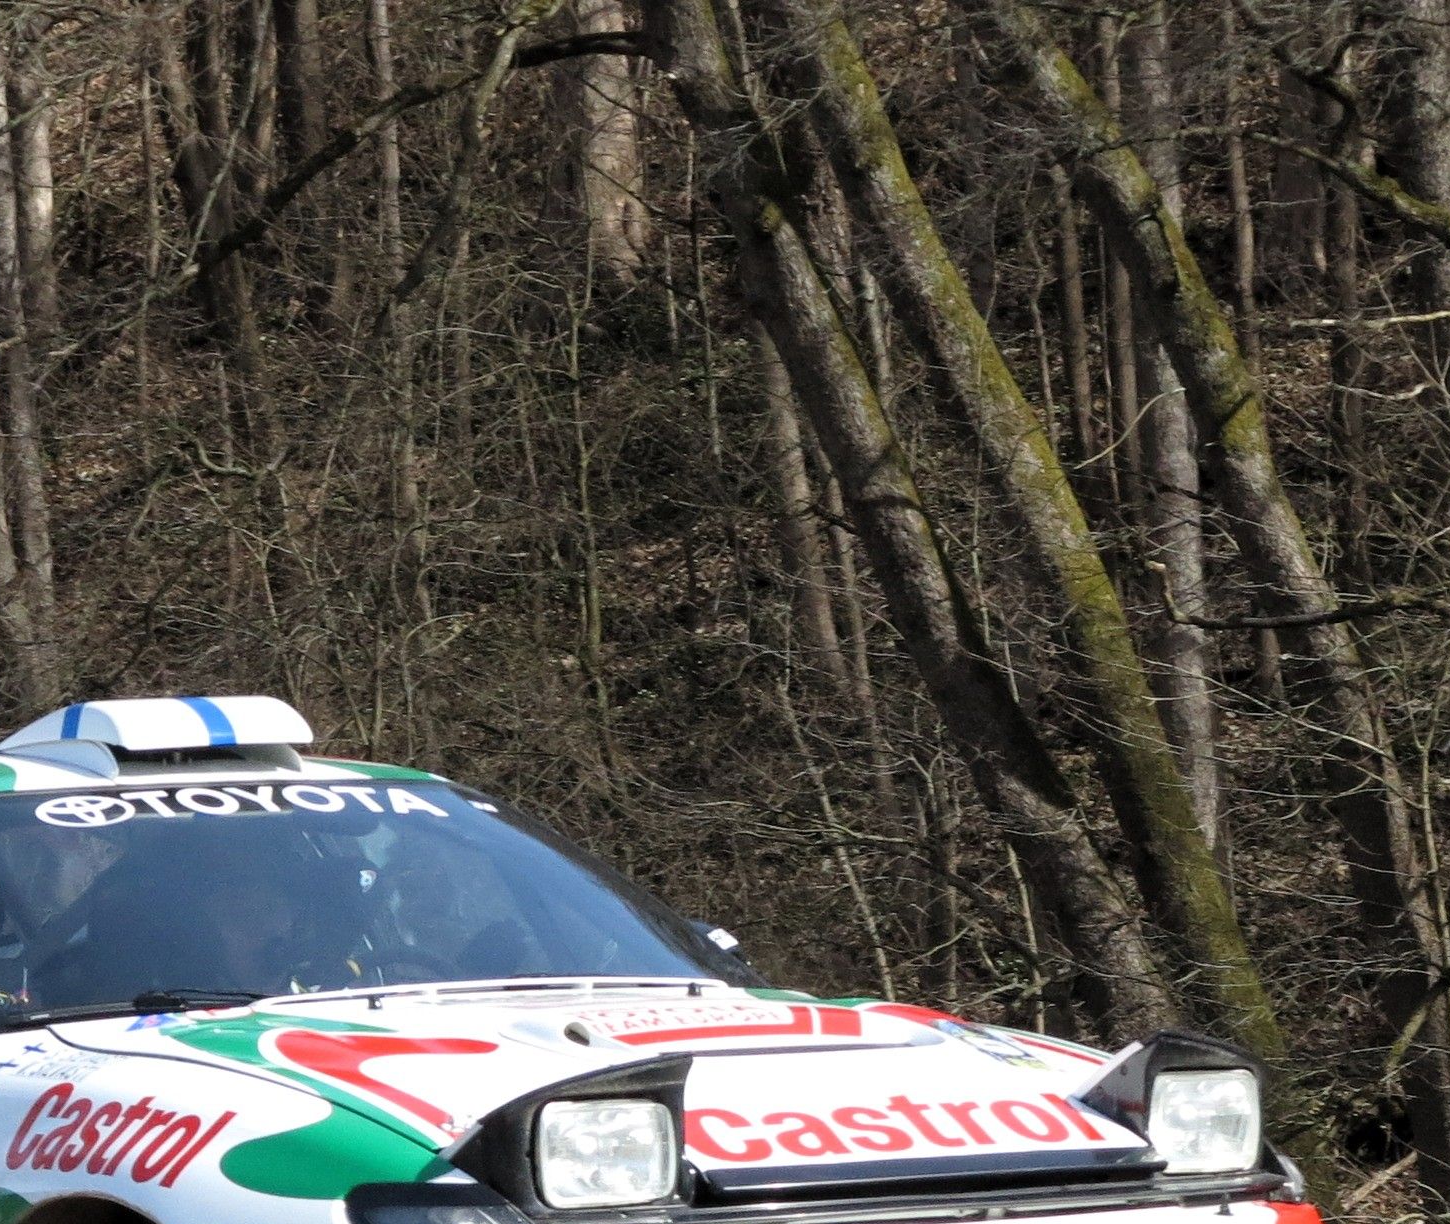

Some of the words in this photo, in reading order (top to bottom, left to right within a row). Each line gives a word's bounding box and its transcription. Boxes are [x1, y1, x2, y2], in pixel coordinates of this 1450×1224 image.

[120, 786, 449, 818] TOYOTA
[6, 1082, 237, 1188] Castrol
[685, 1093, 1105, 1162] Castrol
